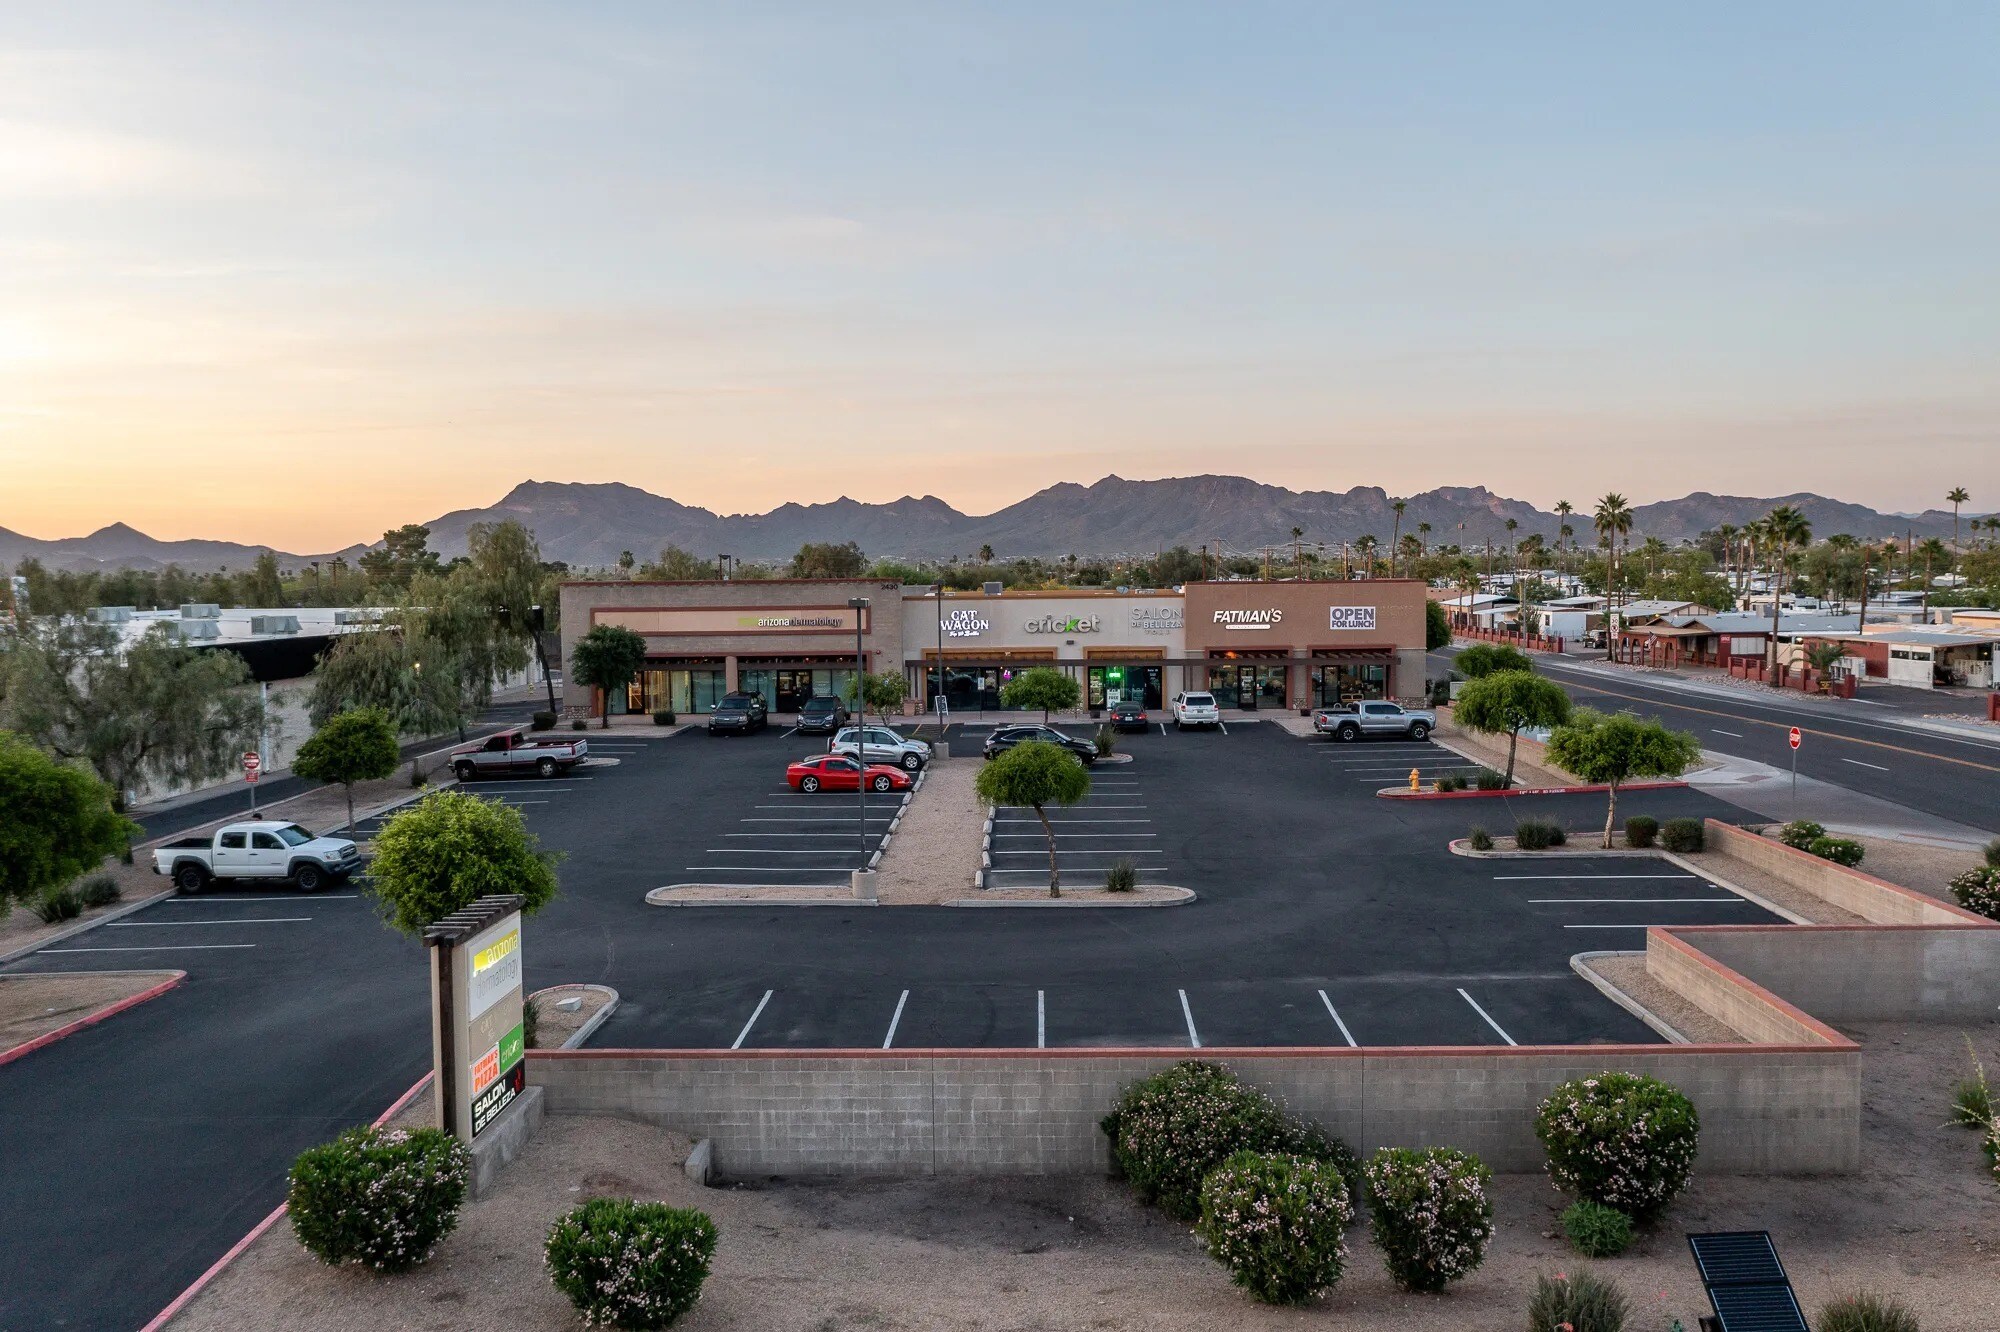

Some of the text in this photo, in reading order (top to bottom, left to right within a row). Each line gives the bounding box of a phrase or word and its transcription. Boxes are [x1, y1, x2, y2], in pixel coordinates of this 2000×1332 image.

[951, 610, 977, 620] CAT
[1132, 608, 1184, 620] SALON
[1213, 608, 1282, 623] FATMAN'S
[1332, 608, 1374, 620] OPEN
[758, 617, 790, 627] arizona
[940, 620, 989, 630] WAGON
[1024, 614, 1100, 633] cricket
[486, 935, 518, 965] arizona
[474, 1062, 498, 1093] PIZZA
[475, 1078, 506, 1118] SALON
[475, 1087, 516, 1133] DE BELLEZA
